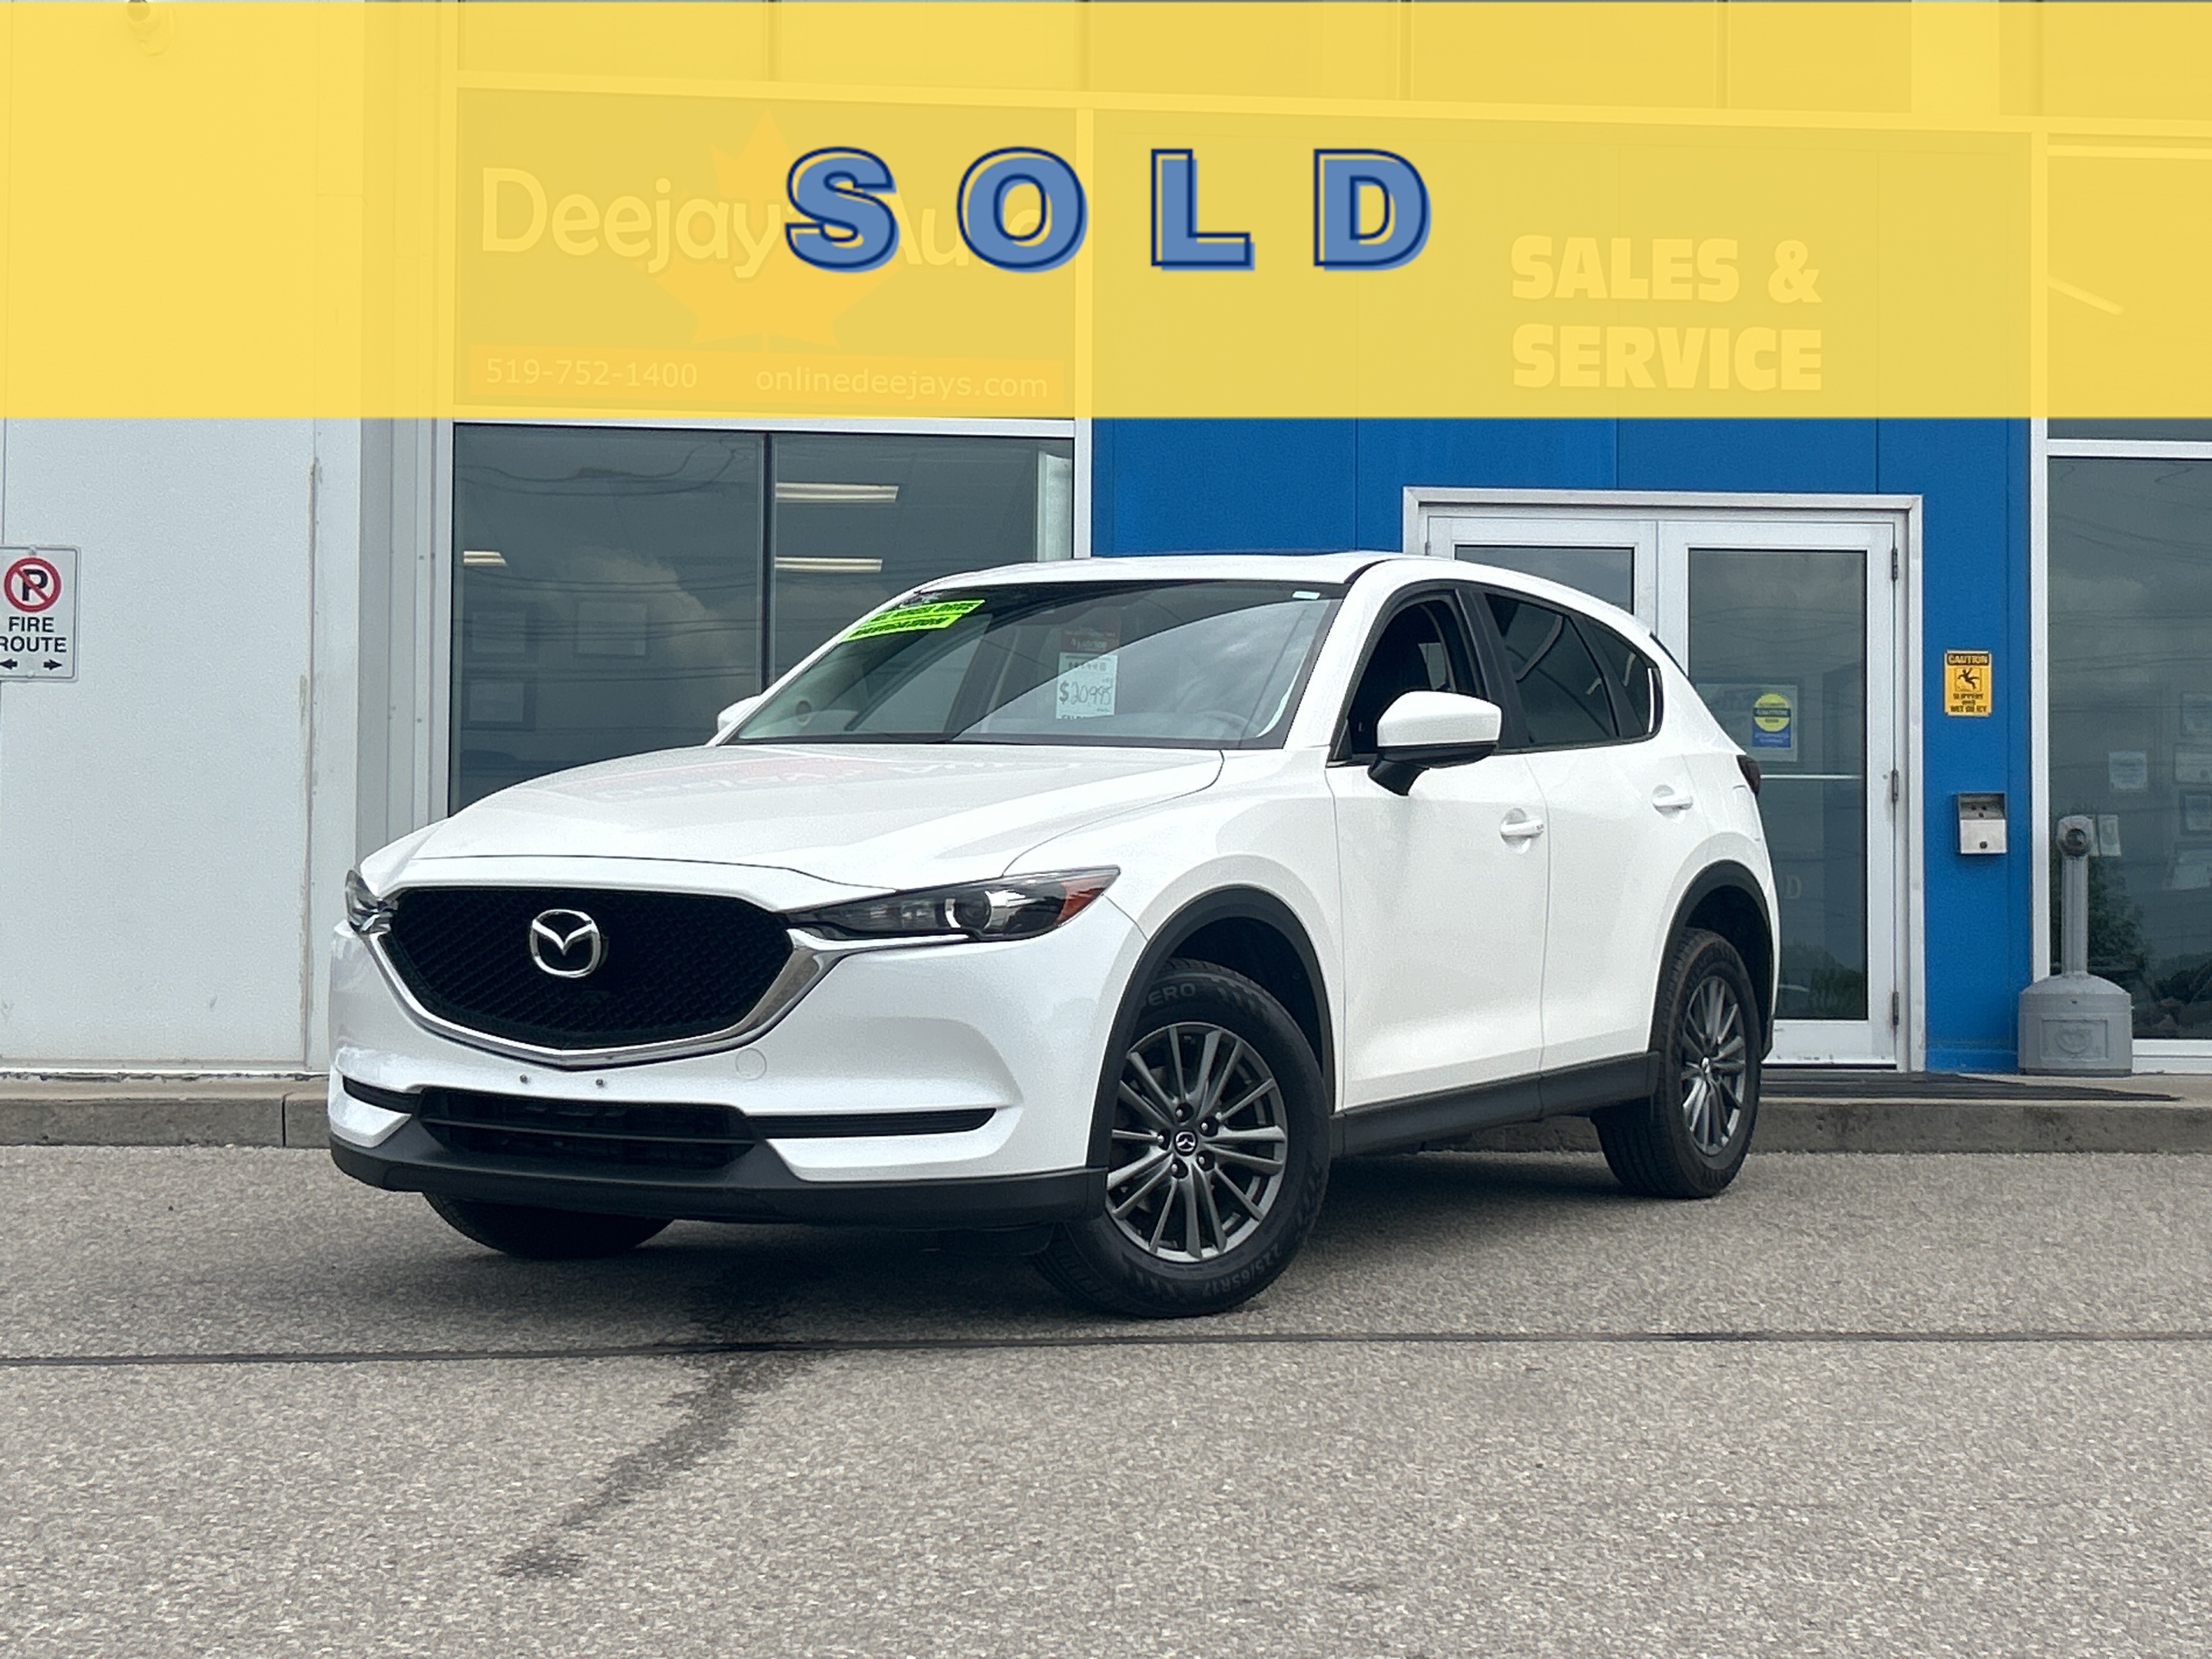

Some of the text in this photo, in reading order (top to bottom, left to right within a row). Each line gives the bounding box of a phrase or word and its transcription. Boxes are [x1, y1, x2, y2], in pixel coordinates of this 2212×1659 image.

[482, 167, 823, 278] Deejay
[1511, 235, 1823, 304] SALES &
[1512, 323, 1822, 392] SERVICE
[486, 357, 1048, 401] 519-752-1400 onlinedeejays.com
[8, 616, 55, 633] FIRE
[0, 636, 67, 653] ROUTE
[1948, 654, 1988, 664] CAUTION
[1148, 982, 1197, 1006] ERO
